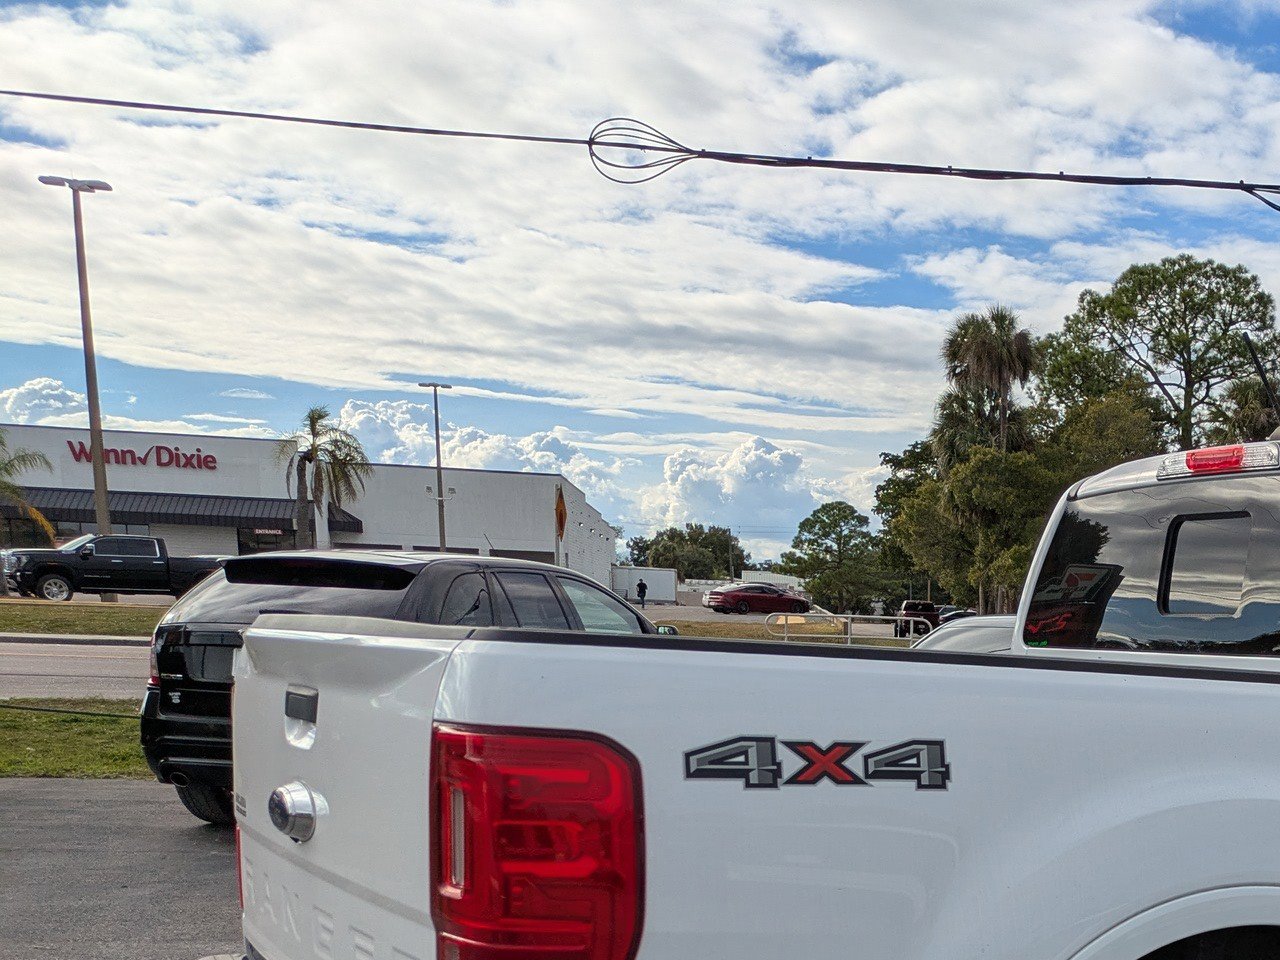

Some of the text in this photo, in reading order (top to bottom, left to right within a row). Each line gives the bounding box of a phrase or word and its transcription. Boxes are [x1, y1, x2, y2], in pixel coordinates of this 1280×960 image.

[66, 440, 217, 470] Wnn Dixie
[684, 735, 951, 790] 4X4
